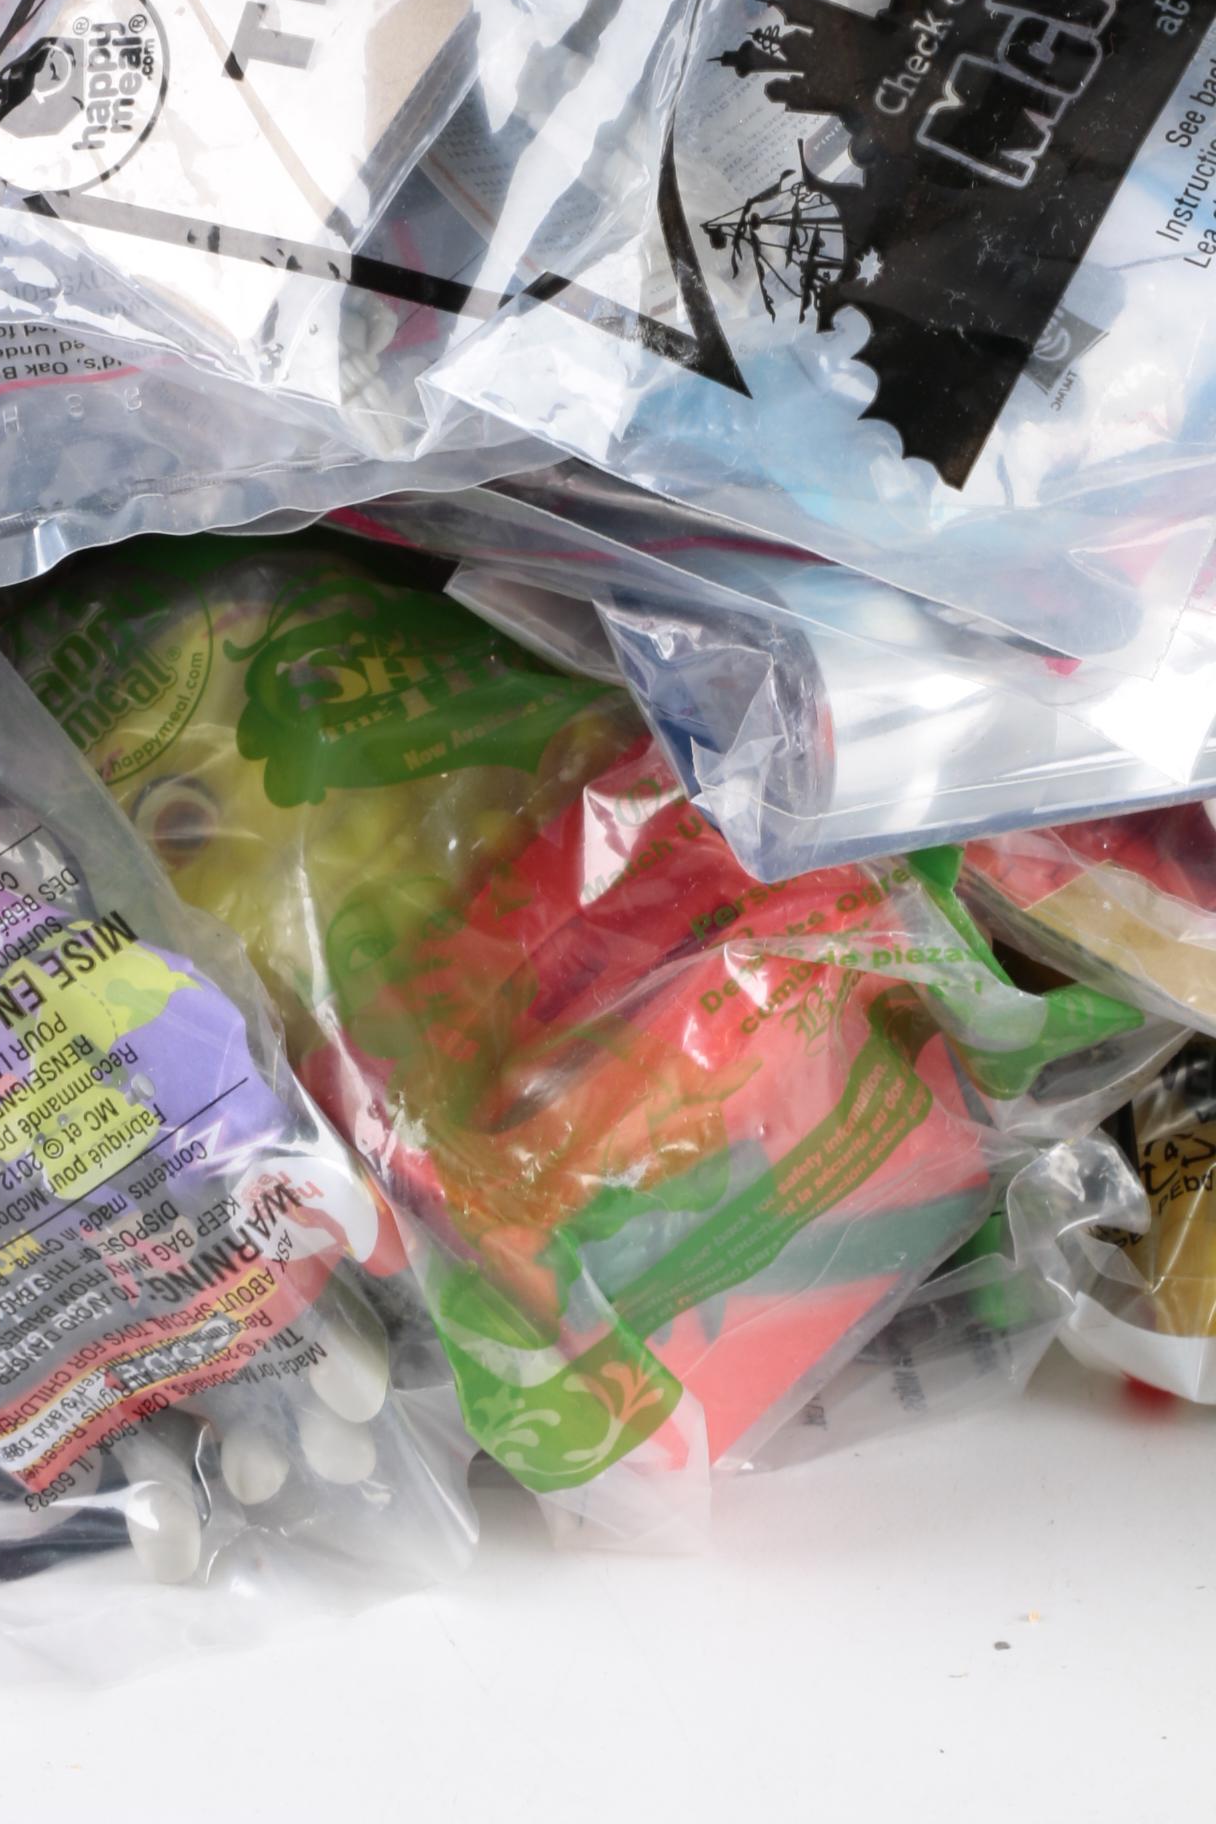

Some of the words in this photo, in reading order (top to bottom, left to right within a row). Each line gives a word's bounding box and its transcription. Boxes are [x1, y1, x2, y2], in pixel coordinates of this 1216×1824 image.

[71, 18, 126, 153] happy
[105, 35, 145, 135] meal
[875, 8, 953, 114] Check
[1165, 110, 1206, 148] See
[24, 360, 69, 382] Oak
[37, 904, 140, 990] MISE
[9, 1009, 71, 1064] POUR
[16, 1041, 140, 1137] Recommandé
[81, 1097, 170, 1170] Fabriqué
[42, 1152, 87, 1190] pour
[126, 1137, 210, 1204] Contents
[77, 1192, 132, 1237] made
[134, 1176, 307, 1308] WARNING:
